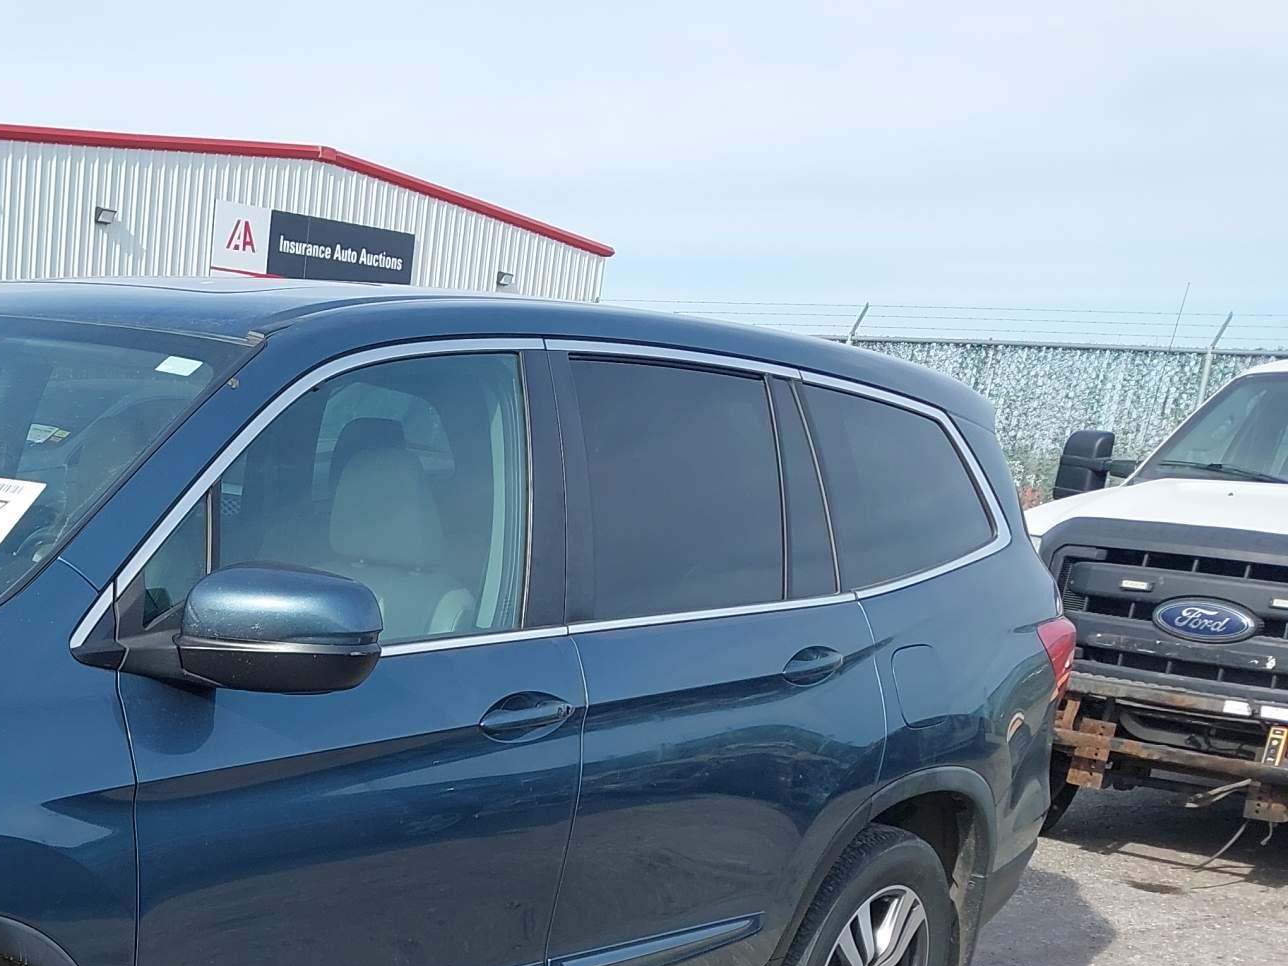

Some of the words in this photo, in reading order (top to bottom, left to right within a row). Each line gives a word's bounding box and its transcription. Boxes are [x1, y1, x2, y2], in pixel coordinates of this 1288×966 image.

[279, 235, 332, 260] Insurance
[334, 244, 357, 264] Auto
[359, 248, 403, 271] Auctions
[1174, 607, 1231, 632] Ford
